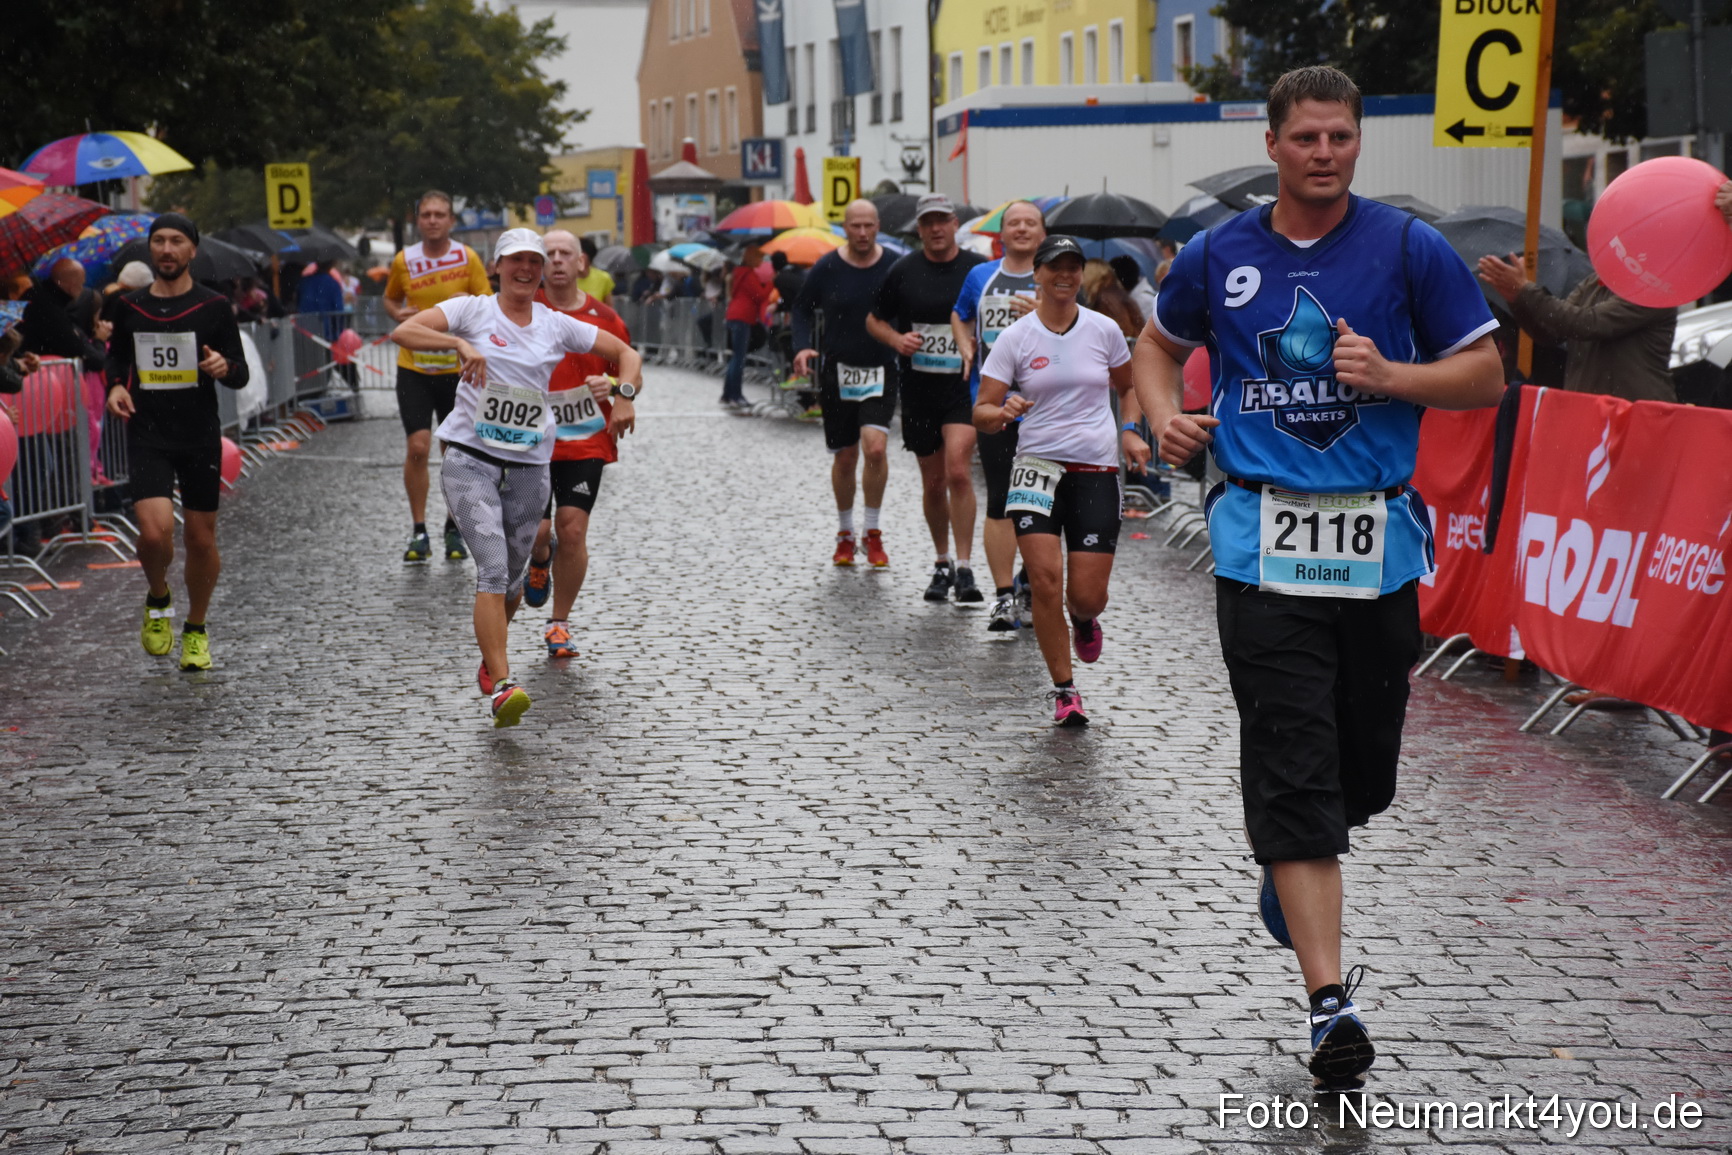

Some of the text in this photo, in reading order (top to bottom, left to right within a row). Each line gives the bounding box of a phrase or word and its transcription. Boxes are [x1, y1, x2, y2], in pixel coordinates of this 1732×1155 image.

[1455, 0, 1541, 15] Block
[1465, 28, 1523, 112] C
[270, 166, 303, 179] Block
[826, 158, 856, 172] Block
[279, 183, 300, 214] D
[832, 177, 852, 206] D
[1224, 265, 1262, 308] 9
[985, 308, 1018, 328] 225
[152, 347, 178, 368] 59
[149, 373, 182, 383] Stephan
[843, 369, 878, 385] 2071
[484, 397, 542, 428] 3092
[551, 397, 595, 425] 3010
[1286, 410, 1346, 423] BASKETS
[1011, 467, 1050, 491] 091
[1275, 510, 1375, 555] 2118
[1295, 563, 1350, 582] Roland
